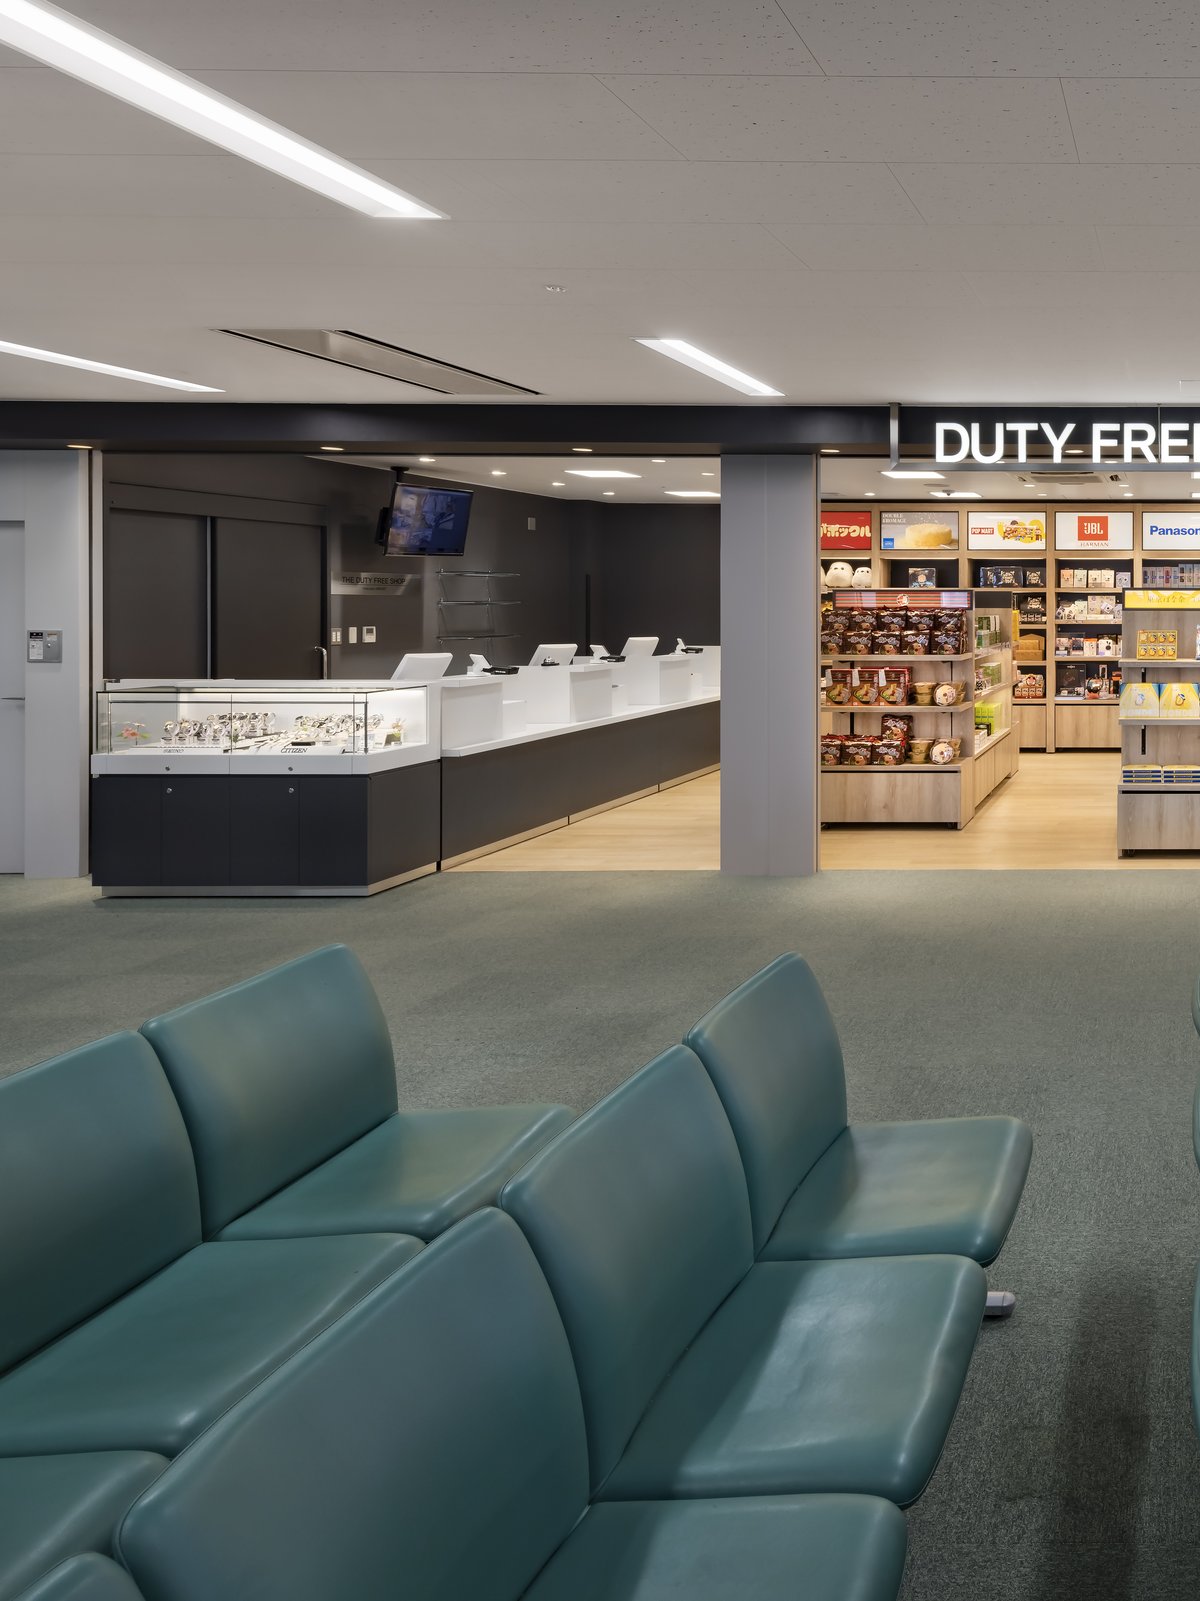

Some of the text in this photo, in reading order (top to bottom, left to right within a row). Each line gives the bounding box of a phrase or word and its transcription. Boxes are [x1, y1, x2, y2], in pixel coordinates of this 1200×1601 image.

[934, 422, 1076, 464] DUTY
[1083, 522, 1104, 535] JBL
[342, 576, 406, 585] THE DUTY FREE SHOP
